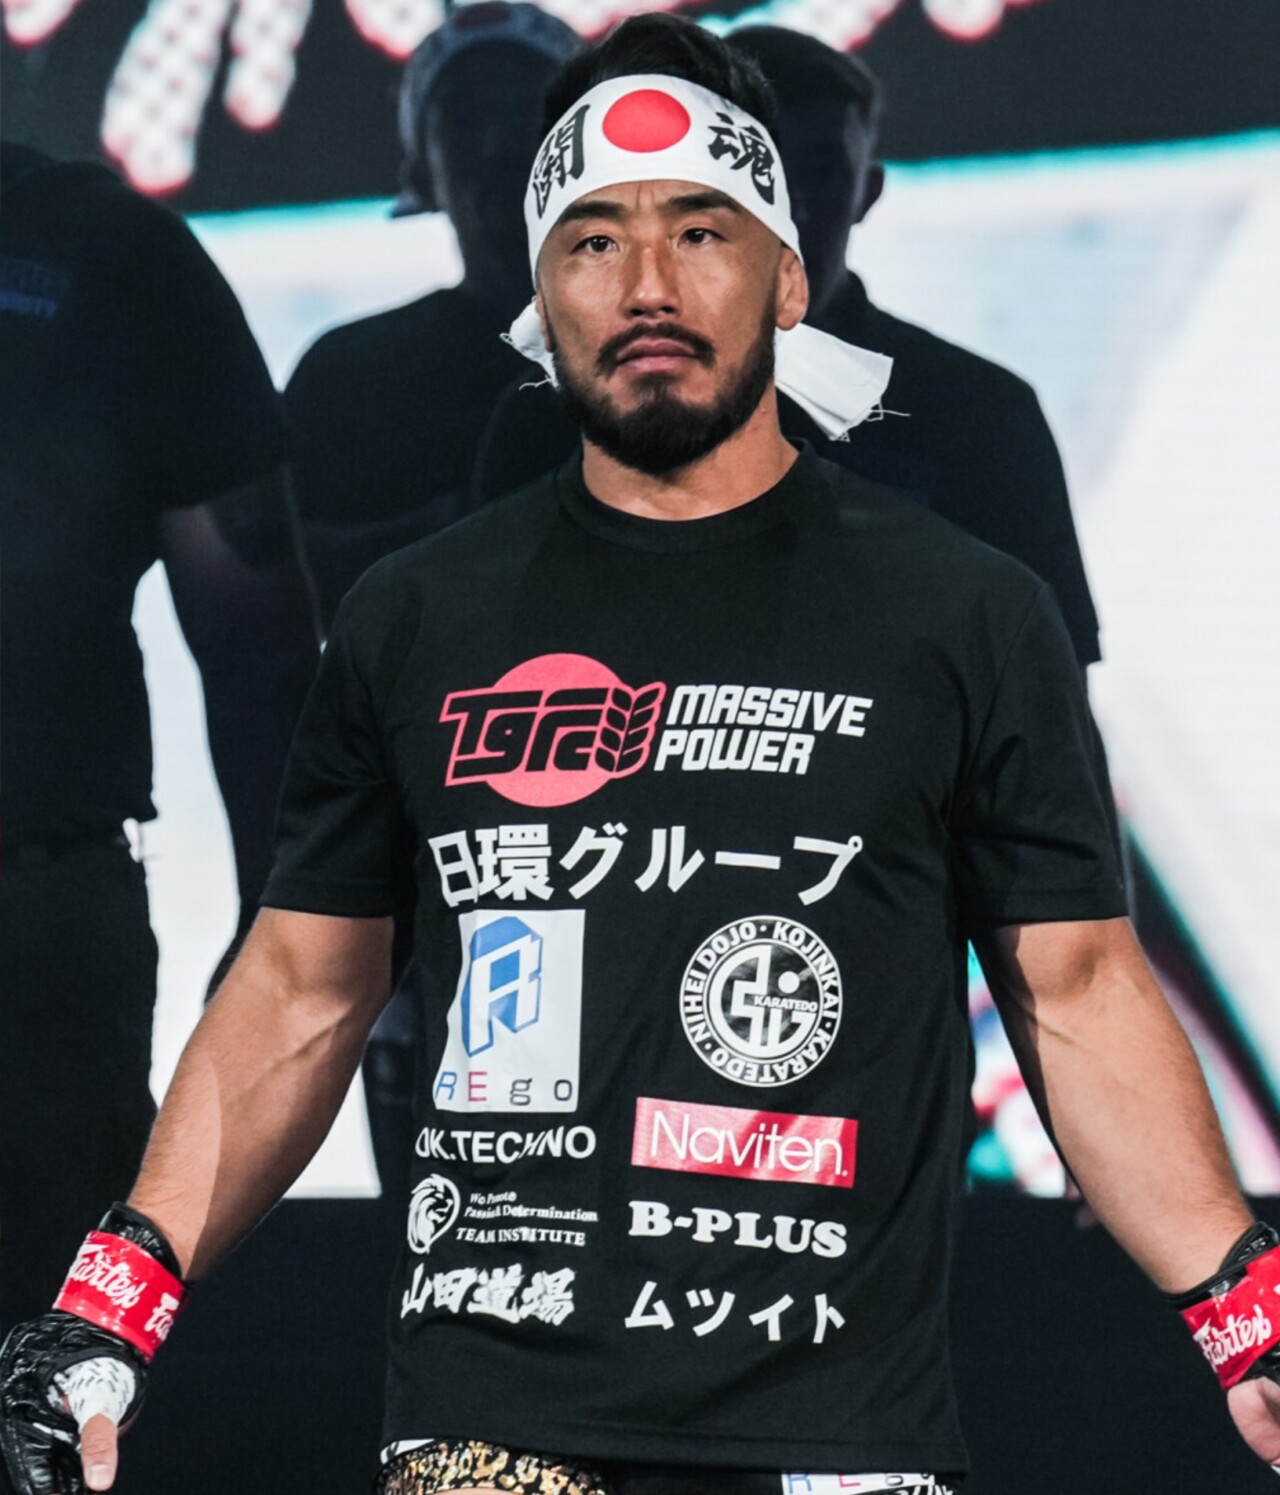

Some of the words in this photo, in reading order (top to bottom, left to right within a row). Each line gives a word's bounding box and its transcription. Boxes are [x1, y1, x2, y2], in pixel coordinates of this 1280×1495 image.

[666, 684, 873, 737] MASSIVE
[654, 729, 815, 775] POWER
[428, 822, 863, 907] 日環グループ
[697, 922, 757, 969] DOJO
[773, 921, 839, 1019] KOJINKAI
[684, 969, 712, 1043] NIHEI
[754, 995, 819, 1013] KARATEDO
[710, 1028, 832, 1083] KARATEDO
[456, 1227, 496, 1243] TEAM
[628, 1200, 847, 1258] B-PLUS
[400, 1263, 577, 1326] 山田道場
